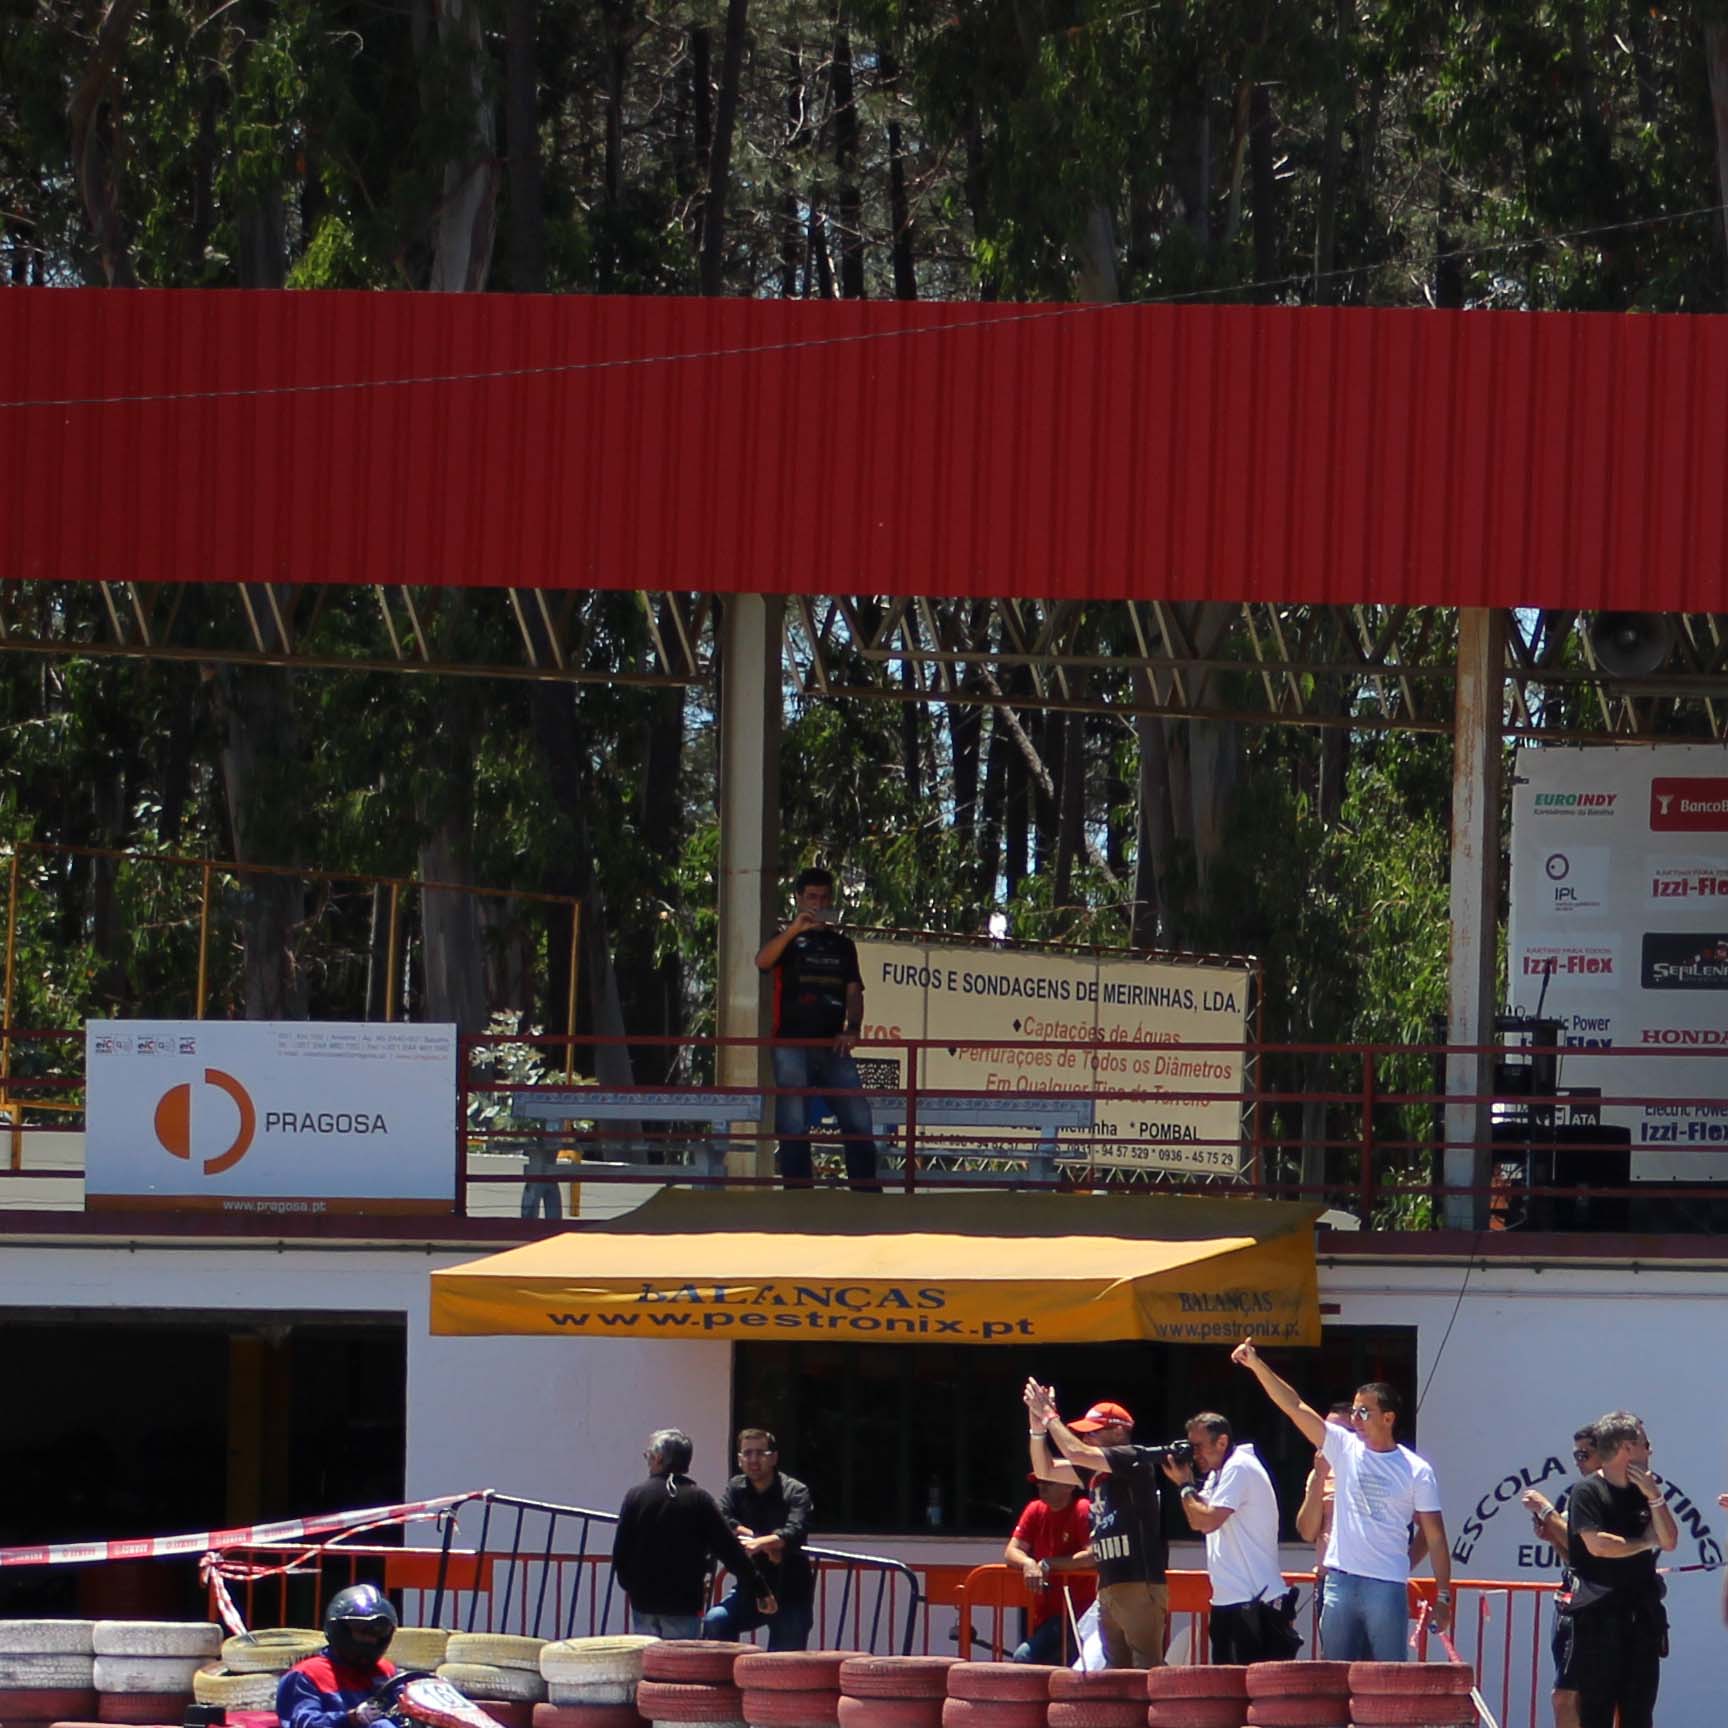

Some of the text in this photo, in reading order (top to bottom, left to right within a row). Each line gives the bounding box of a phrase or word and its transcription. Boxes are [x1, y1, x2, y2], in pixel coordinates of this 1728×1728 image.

[1534, 793, 1617, 807] EUROINDY
[1554, 888, 1578, 900] IPL
[882, 962, 1241, 1013] FUROS E SONDAGENS DE MEIRINHAS, LDA.
[1023, 1015, 1105, 1042] Captações
[1110, 1023, 1129, 1042] de
[1572, 1015, 1610, 1031] Power
[1057, 1050, 1077, 1068] de
[1082, 1050, 1128, 1073] Todos
[1133, 1058, 1150, 1074] os
[1155, 1053, 1232, 1079] Diâmetros
[265, 1112, 388, 1134] PRAGOSA
[1139, 1122, 1199, 1141] POMBAL
[223, 1200, 327, 1214] www.pragosa.pt
[1179, 1291, 1274, 1315] BALANÇAS
[547, 1311, 1036, 1338] www.pestronix.pt
[1451, 1456, 1568, 1565] ESCOLA
